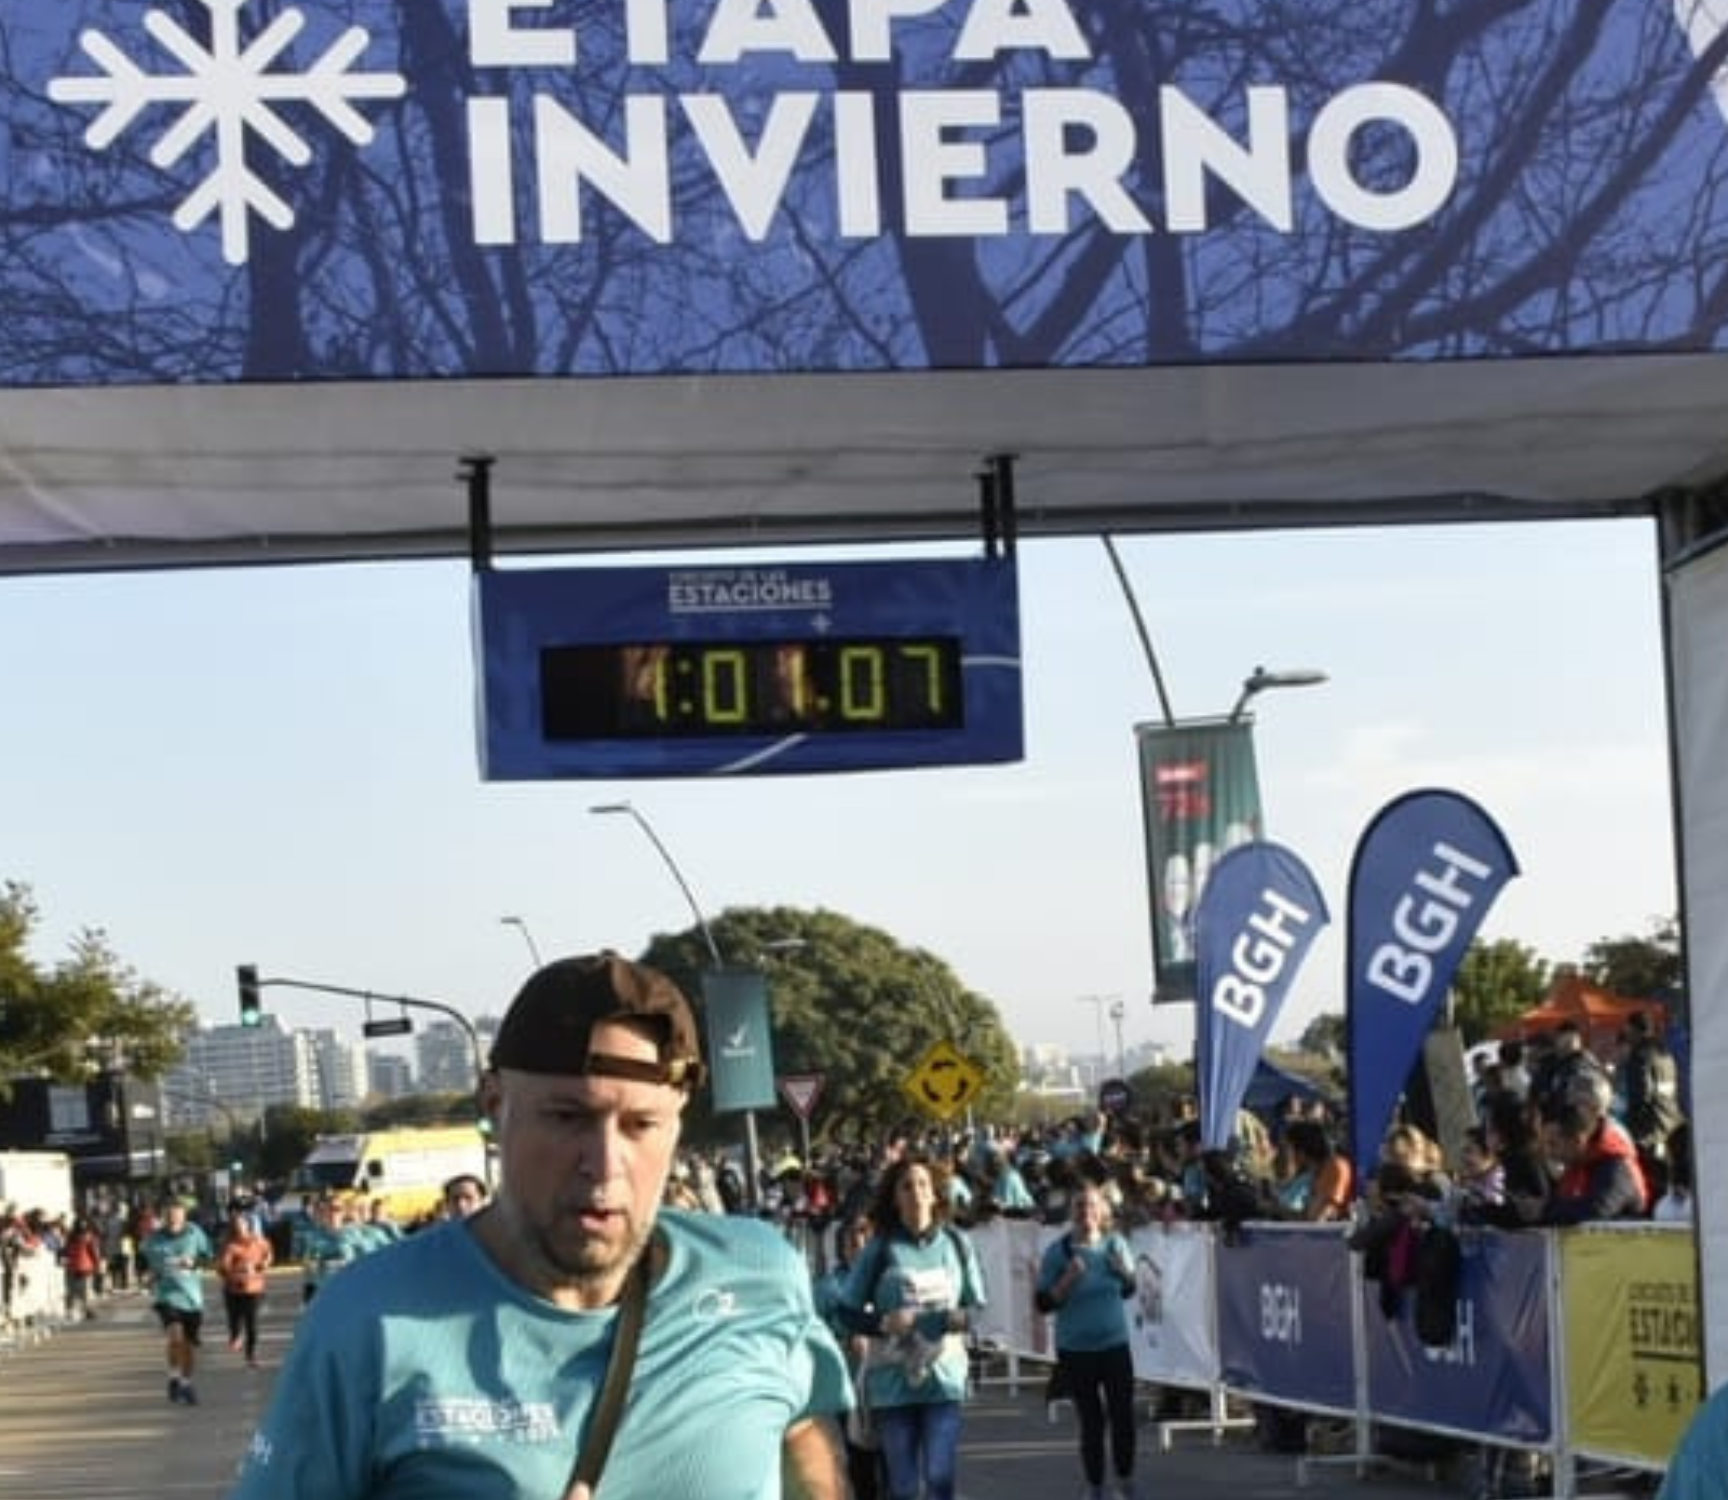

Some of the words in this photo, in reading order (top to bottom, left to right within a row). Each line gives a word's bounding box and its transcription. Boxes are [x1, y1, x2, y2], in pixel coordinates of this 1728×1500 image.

[467, 81, 1458, 244] INVIERNO
[1214, 888, 1311, 1028] BGH
[1367, 842, 1492, 1003] BGH
